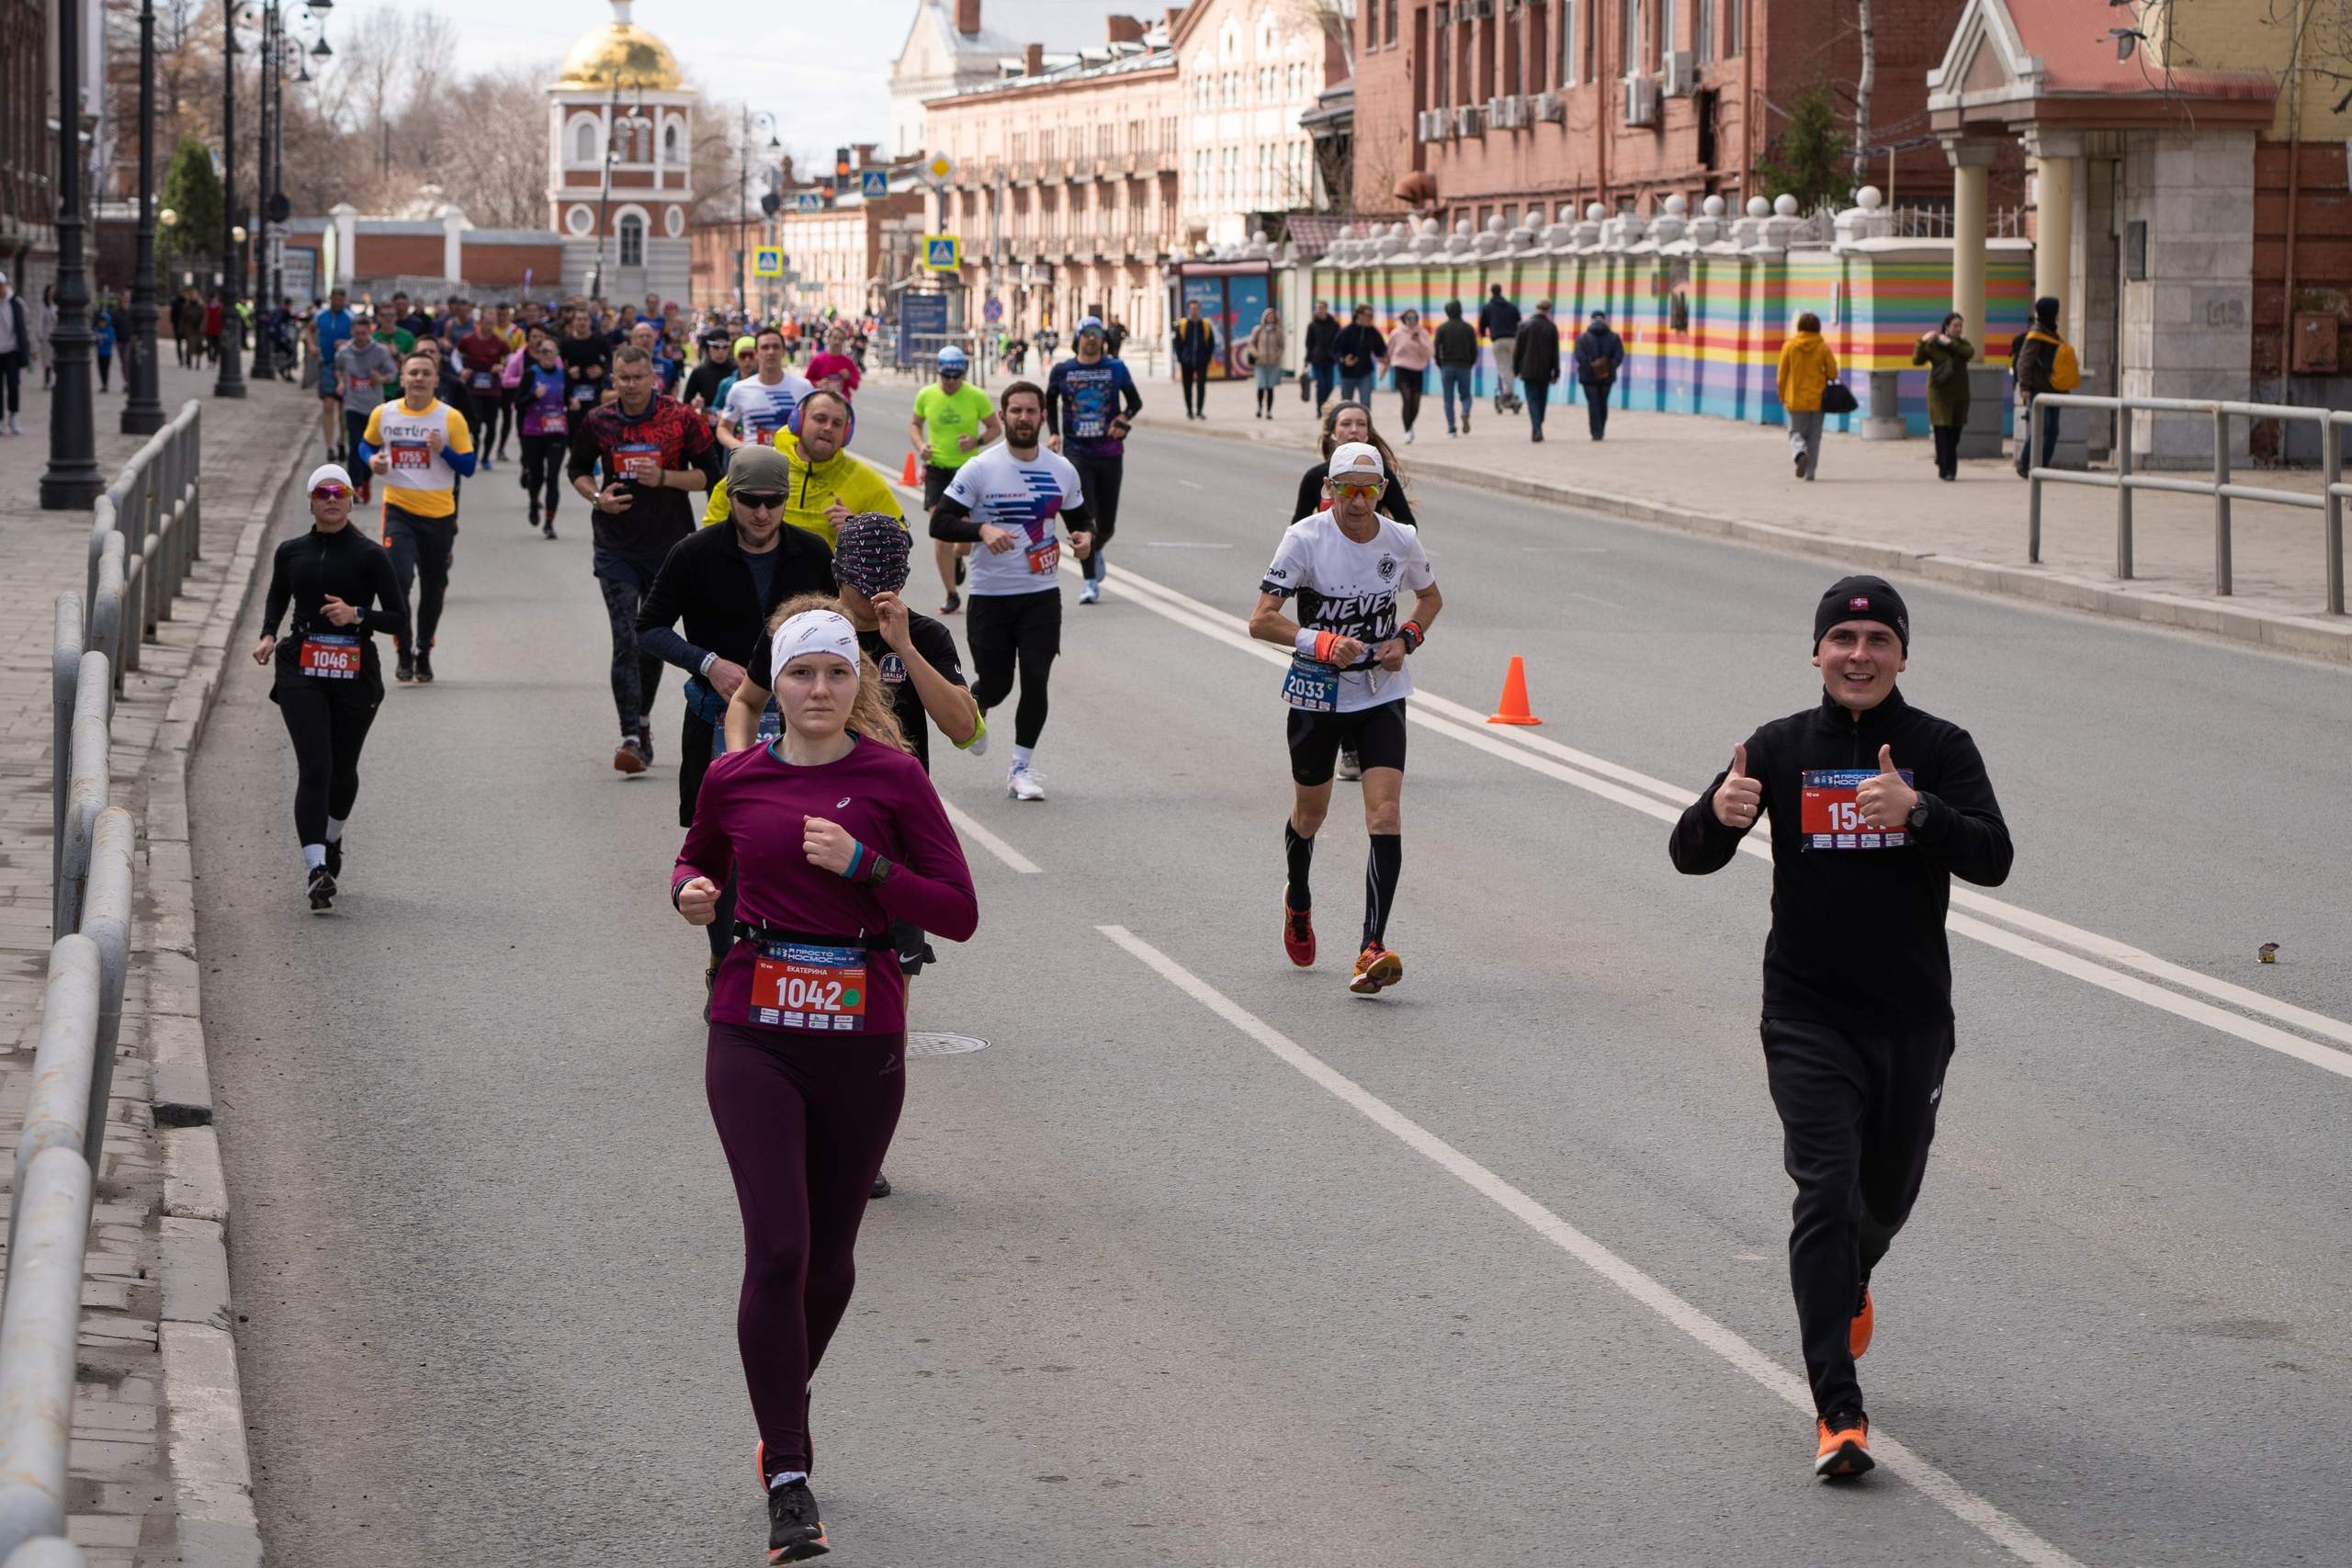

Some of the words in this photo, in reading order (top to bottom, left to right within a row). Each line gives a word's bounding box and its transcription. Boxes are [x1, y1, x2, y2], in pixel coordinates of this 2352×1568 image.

[313, 650, 348, 669] 1046
[1288, 675, 1325, 699] 2033
[788, 954, 833, 964] КОСМОС
[796, 949, 833, 957] ПРОСТО
[786, 965, 828, 976] ЕКАТЕРИНА
[776, 977, 842, 1010] 1042
